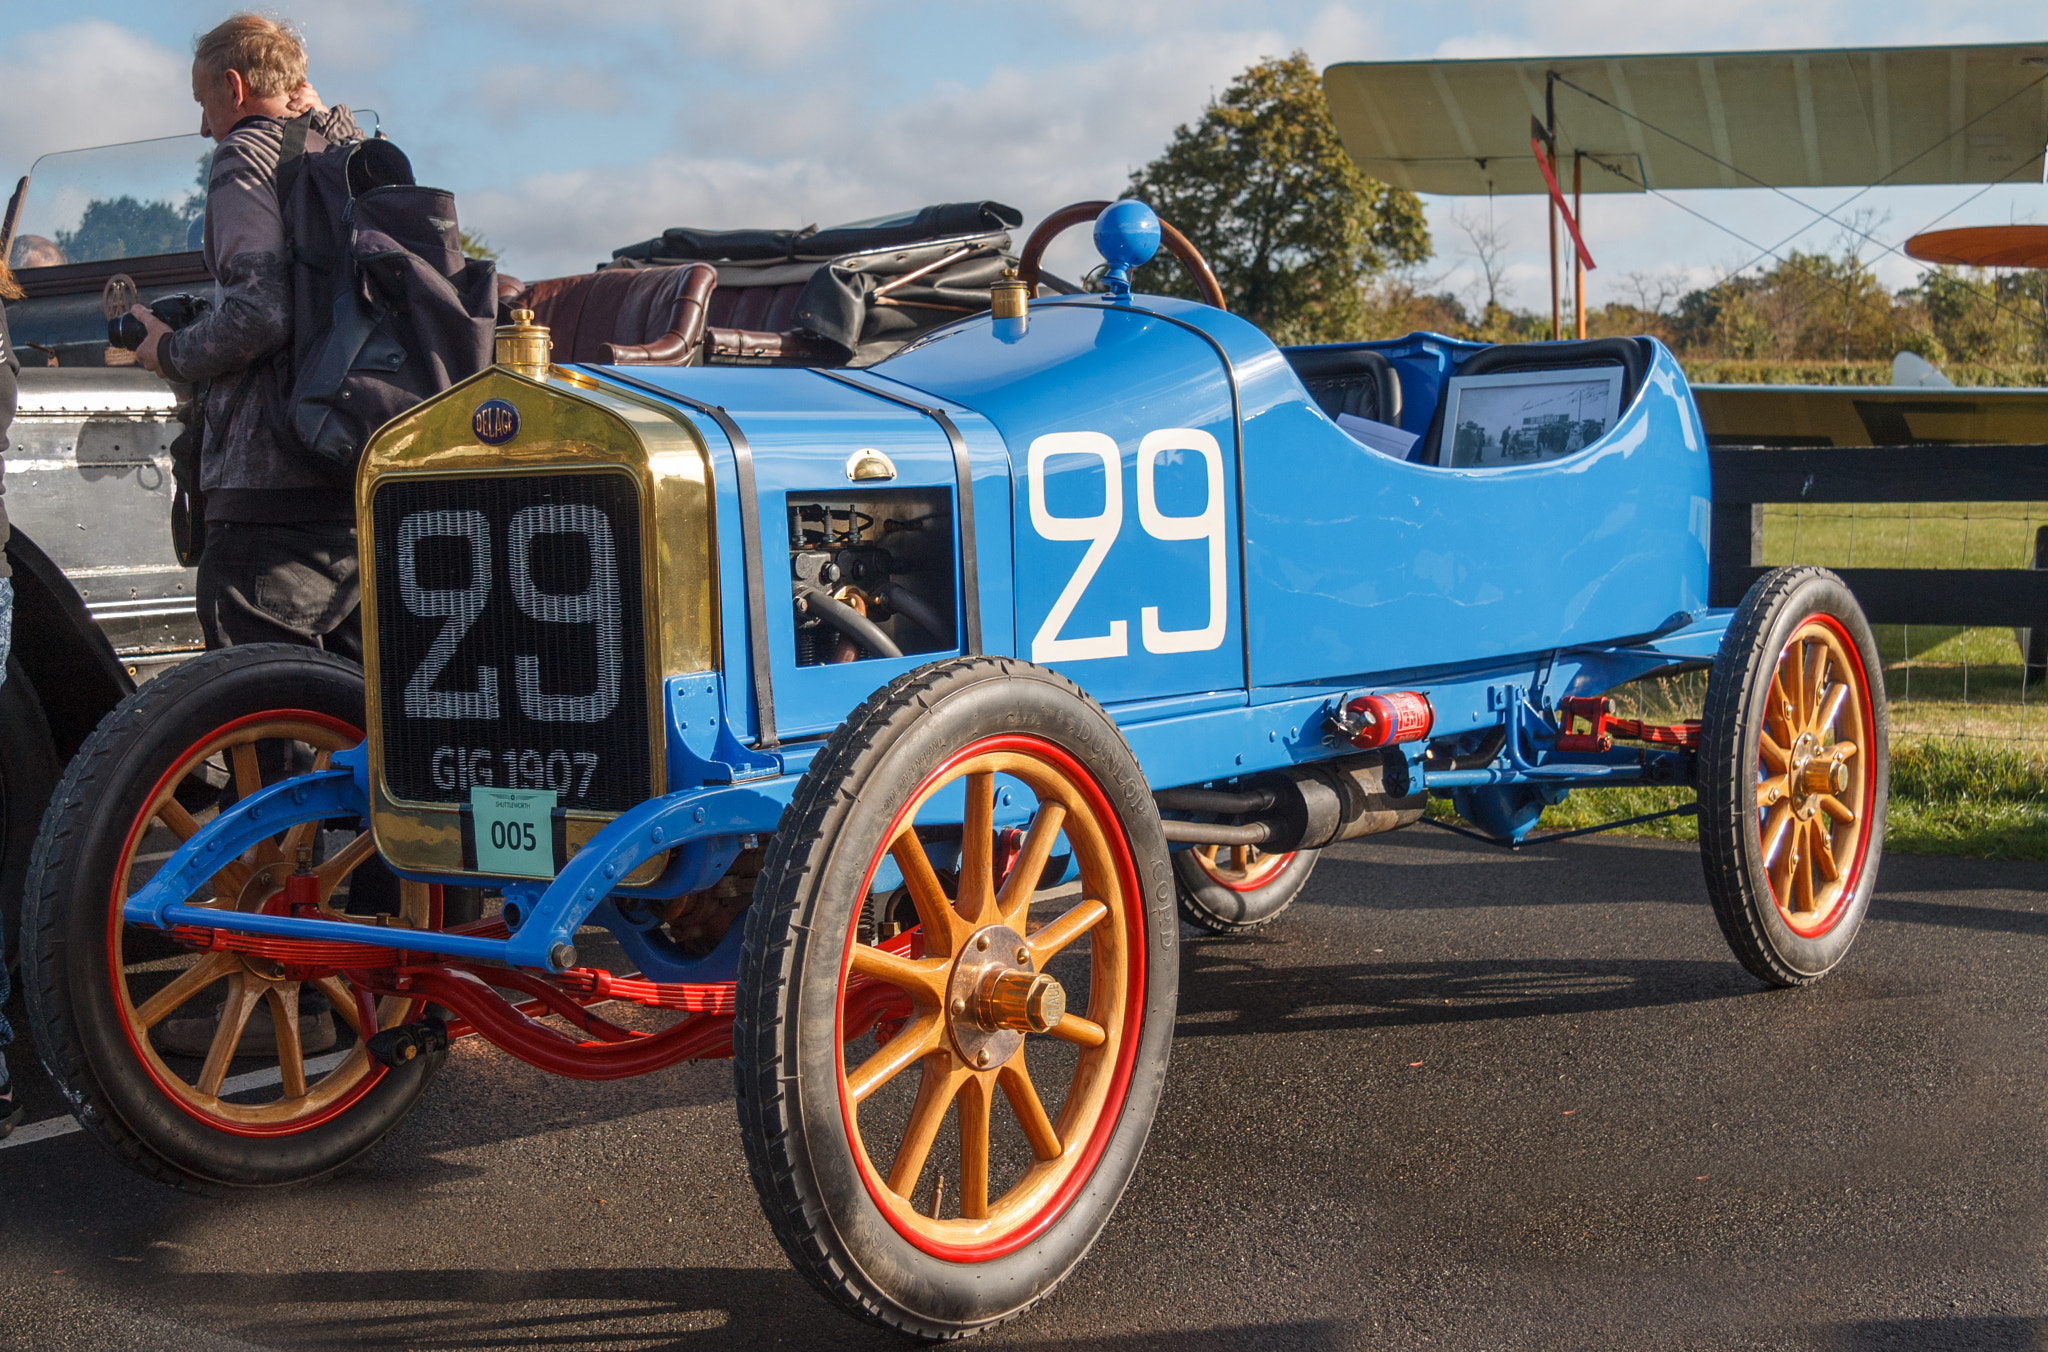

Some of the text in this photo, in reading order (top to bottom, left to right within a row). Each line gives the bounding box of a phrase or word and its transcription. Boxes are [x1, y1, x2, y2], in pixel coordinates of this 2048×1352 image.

[476, 407, 513, 438] DELAGE
[1028, 428, 1227, 664] 29
[398, 504, 623, 723] 29
[432, 745, 599, 797] GIG 1907
[1077, 708, 1148, 817] DUNLOP
[495, 801, 531, 809] SHUTTLEWORTH
[491, 820, 537, 852] 005
[1152, 860, 1176, 952] CORD
[1046, 983, 1060, 1027] DELAGE
